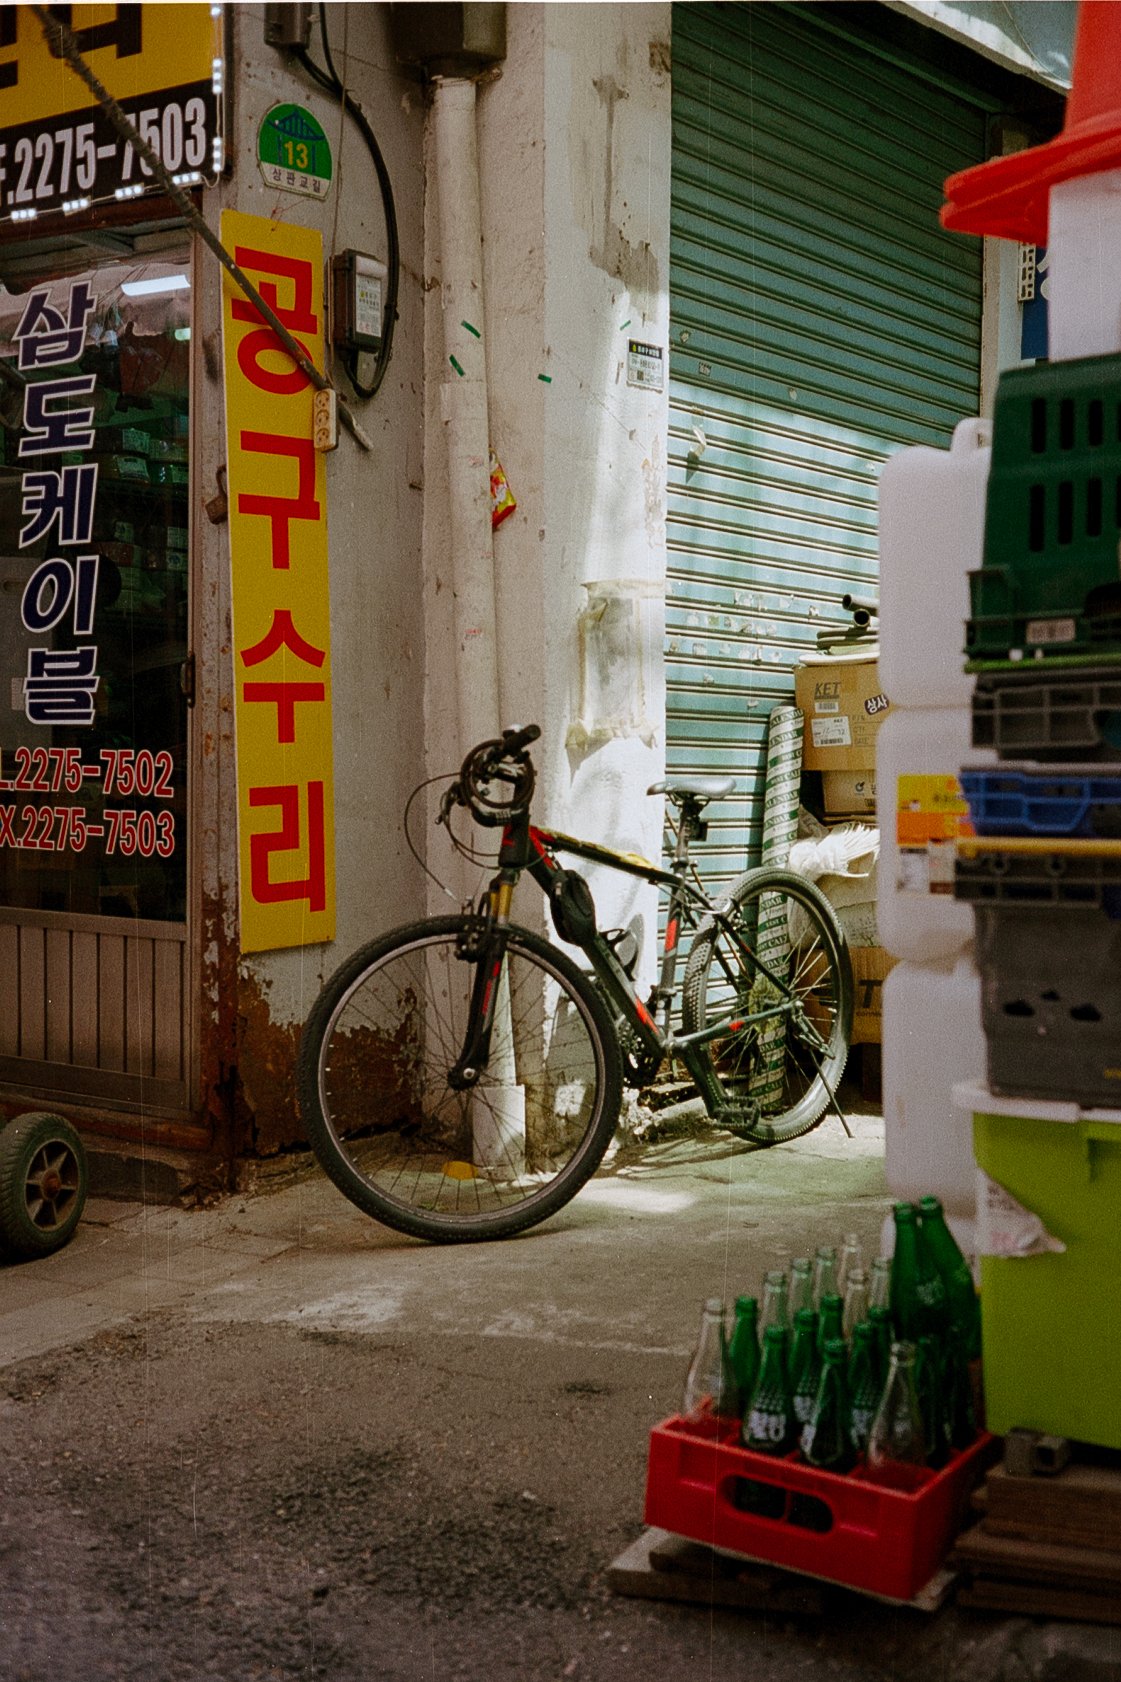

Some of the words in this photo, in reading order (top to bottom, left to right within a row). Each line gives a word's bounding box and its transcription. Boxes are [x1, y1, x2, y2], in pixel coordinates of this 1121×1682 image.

[284, 141, 309, 169] 13
[11, 280, 99, 725] 삼도케이블
[231, 246, 326, 913] 공구수리
[815, 682, 841, 695] KET
[866, 694, 888, 713] 상사
